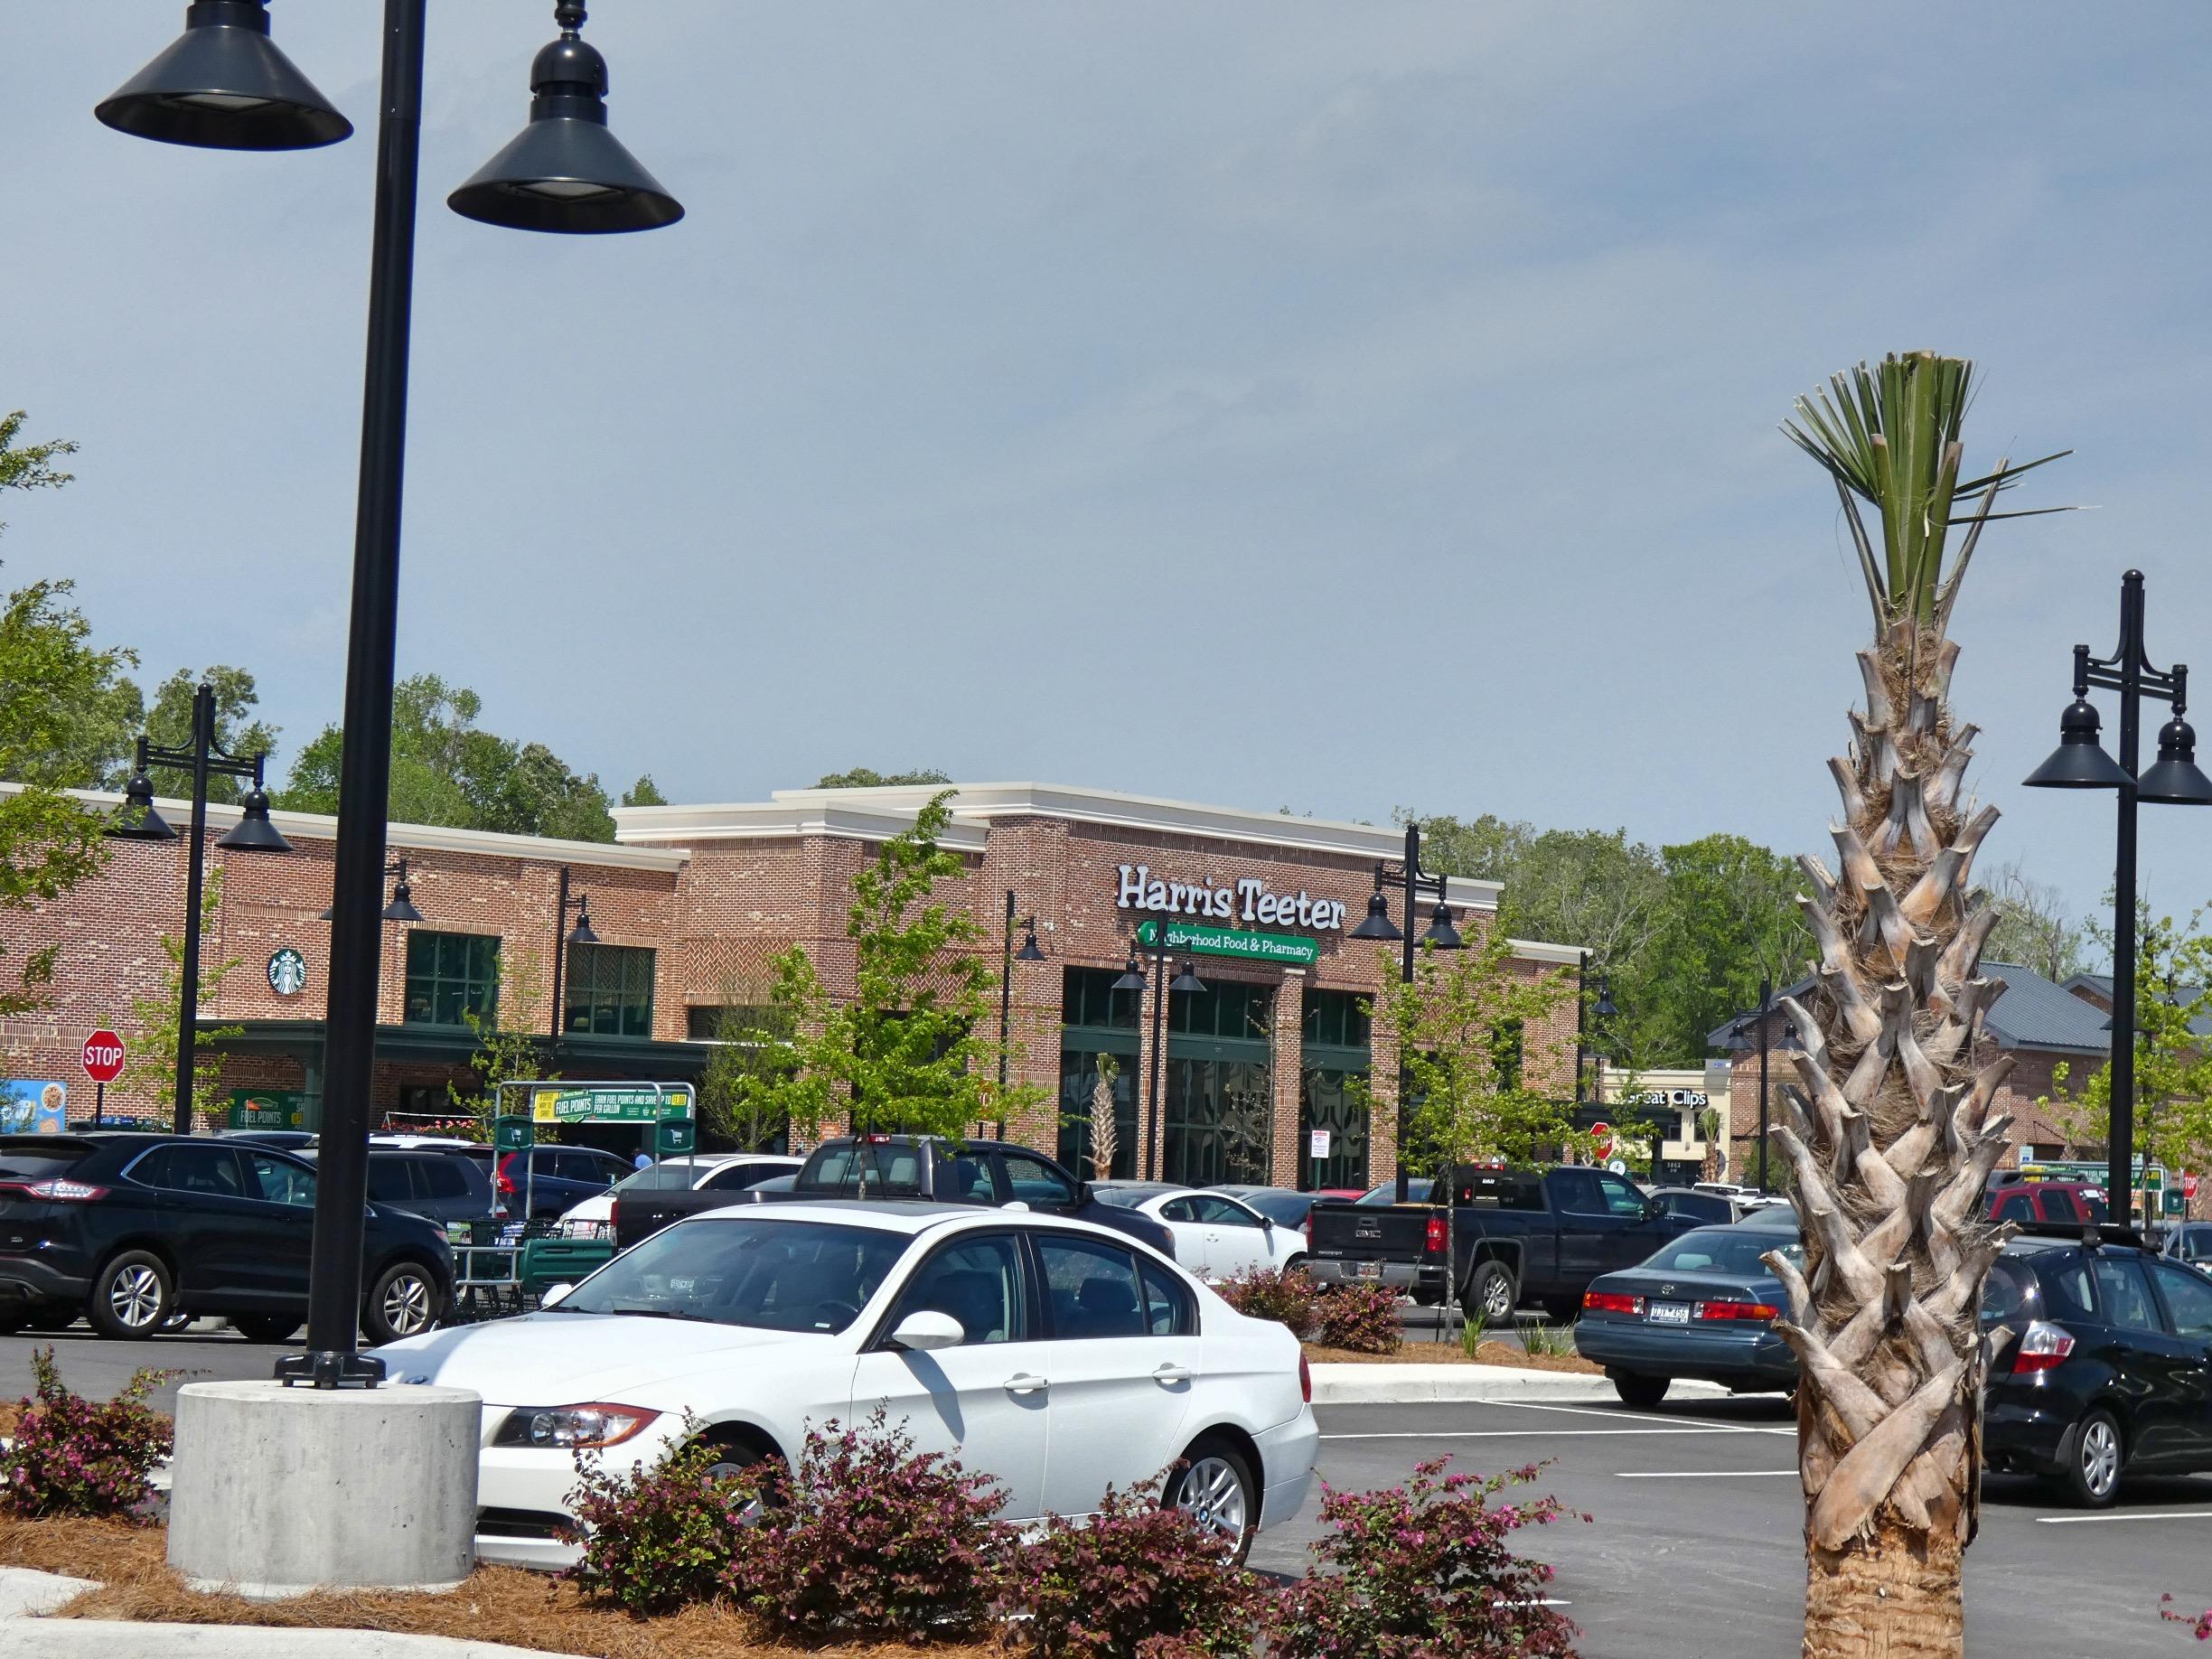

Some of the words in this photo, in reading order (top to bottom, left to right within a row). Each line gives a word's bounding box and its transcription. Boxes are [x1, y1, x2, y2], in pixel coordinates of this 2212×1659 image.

[1117, 865, 1233, 918] Harris
[1238, 878, 1346, 930] Teeter
[1148, 928, 1222, 949] Nghborhood
[1223, 935, 1247, 951] Food
[1250, 938, 1261, 951] &
[1261, 942, 1314, 961] Pharmacy
[85, 1045, 123, 1066] STOP
[556, 1100, 570, 1115] FUEL
[570, 1097, 592, 1113] POINTS
[595, 1094, 607, 1104] EARN
[606, 1094, 617, 1104] FUEL
[617, 1095, 634, 1104] POINTS
[634, 1095, 644, 1104] AND
[644, 1095, 657, 1105] SAVE
[665, 1095, 671, 1105] TO
[1673, 1089, 1707, 1109] Clips
[594, 1104, 603, 1113] PER
[603, 1104, 621, 1113] GALLON
[240, 1110, 258, 1123] FUEL
[258, 1111, 281, 1124] POINTS
[2184, 1176, 2197, 1189] TOP
[1355, 1230, 1381, 1238] GMC
